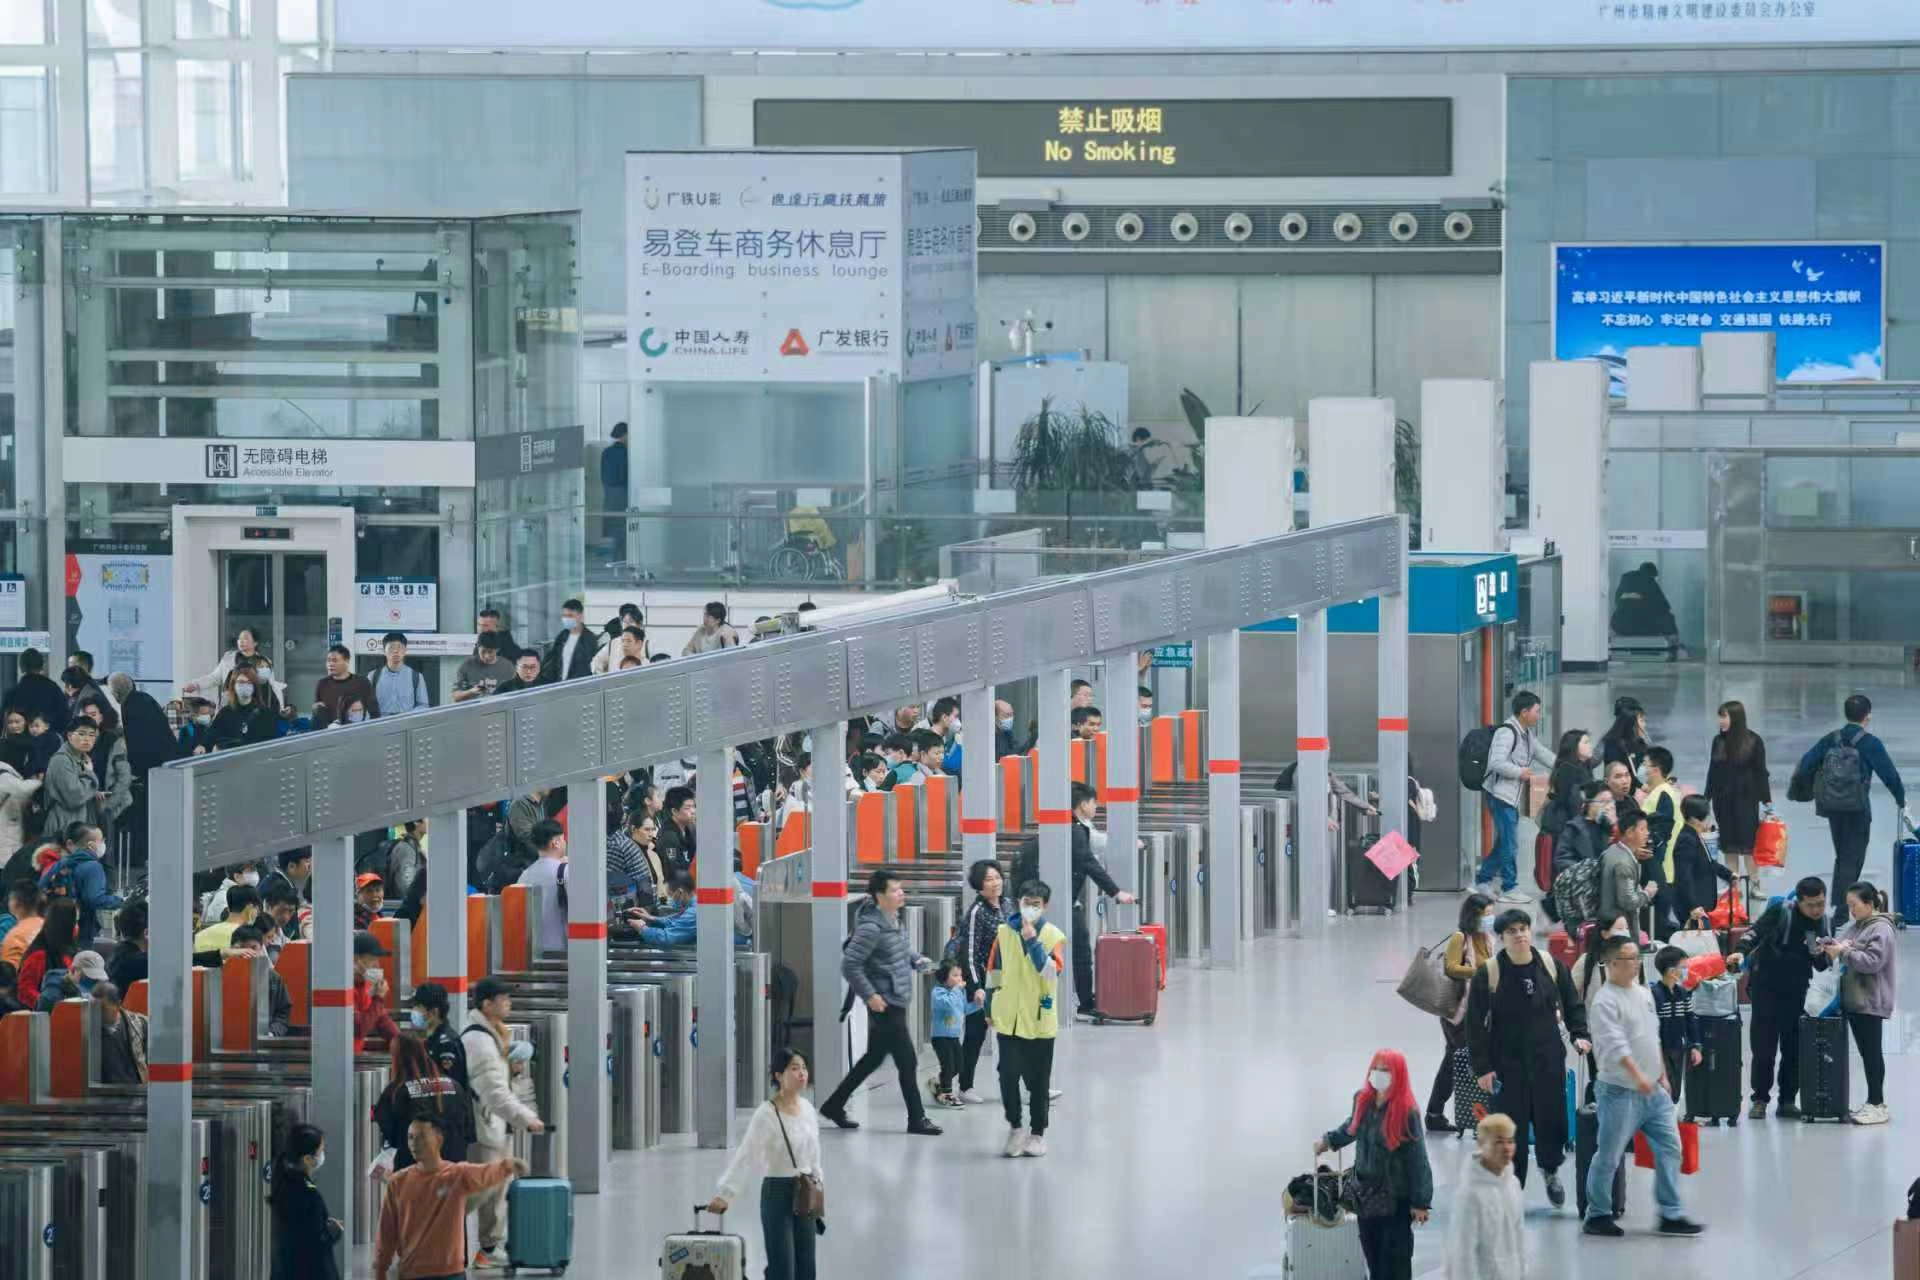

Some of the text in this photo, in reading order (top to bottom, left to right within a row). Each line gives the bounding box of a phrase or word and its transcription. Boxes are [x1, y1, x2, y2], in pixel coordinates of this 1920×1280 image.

[1058, 106, 1162, 134] 禁止吸烟
[1045, 139, 1176, 165] No Smoking
[643, 228, 887, 259] 易登车商务休息厅
[641, 262, 735, 279] E-Boarding
[748, 263, 819, 277] business
[832, 263, 888, 280] lounge
[1571, 289, 1862, 305] 高举习近平新时代中国特色社会主义思想伟大旗帜
[1601, 311, 1833, 327] 不忘初心 牢记使命 交通强国 铁路先行
[674, 328, 749, 346] 中国人寿
[818, 329, 889, 348] 广发银行
[242, 447, 328, 465] 无障碍电梯
